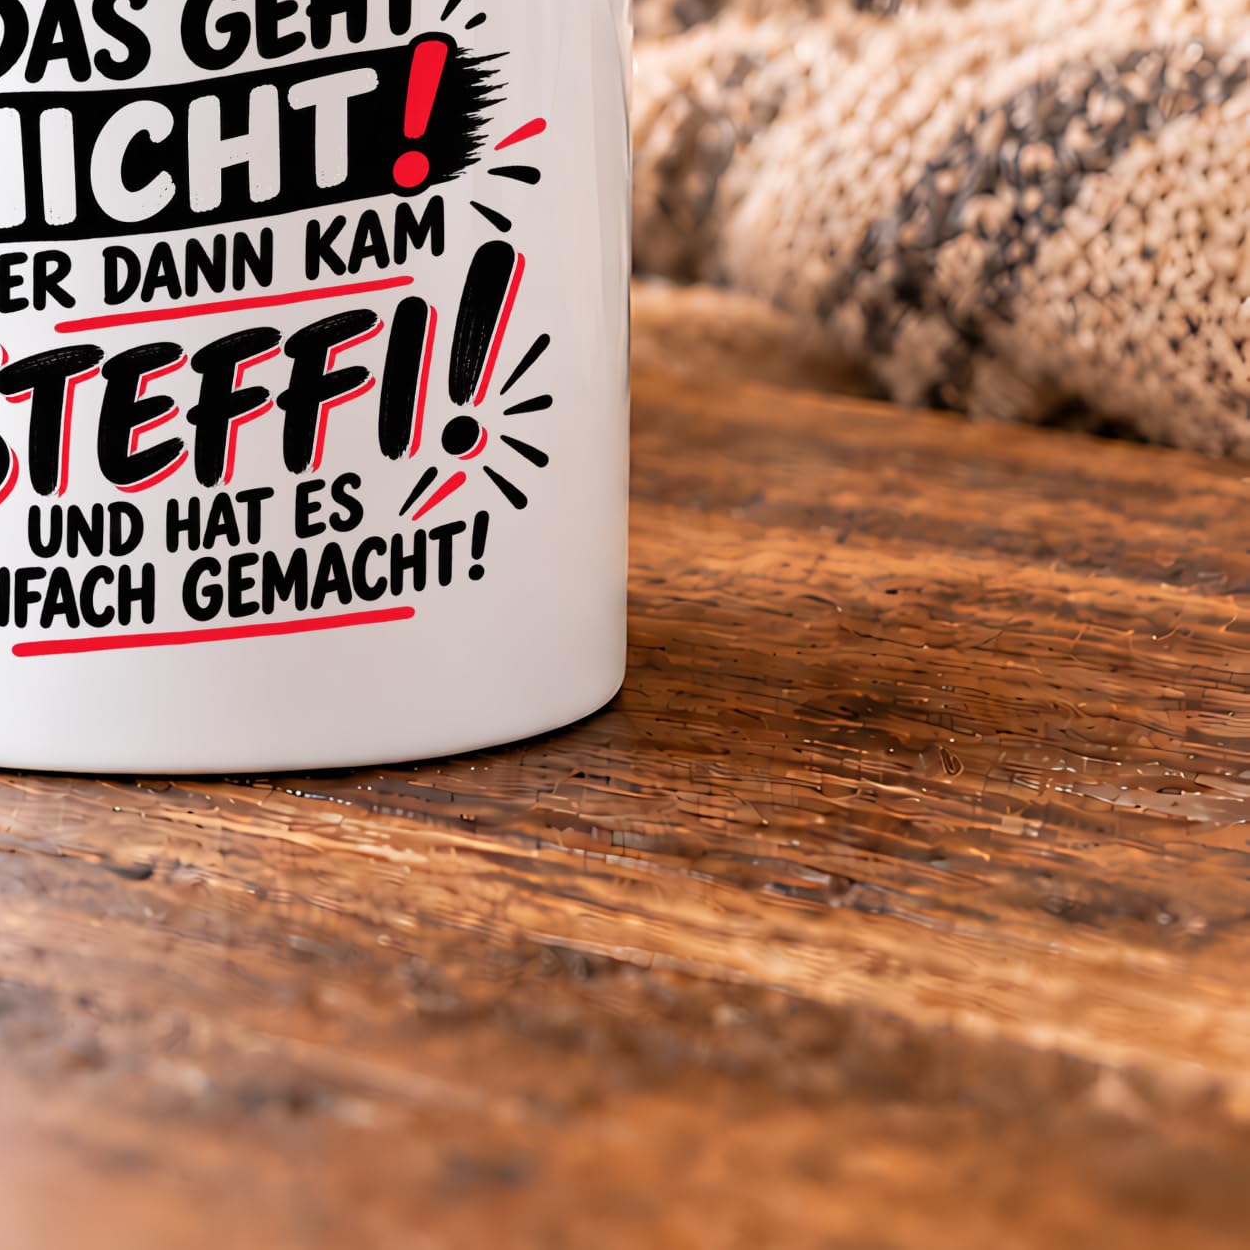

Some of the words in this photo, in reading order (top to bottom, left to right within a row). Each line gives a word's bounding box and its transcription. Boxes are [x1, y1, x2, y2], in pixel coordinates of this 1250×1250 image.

[102, 230, 274, 306] DANN
[304, 195, 445, 279] KAM
[27, 500, 144, 558] UND
[166, 486, 275, 550] HAT
[294, 472, 365, 540] ES
[181, 510, 491, 619] GEMACHT!
